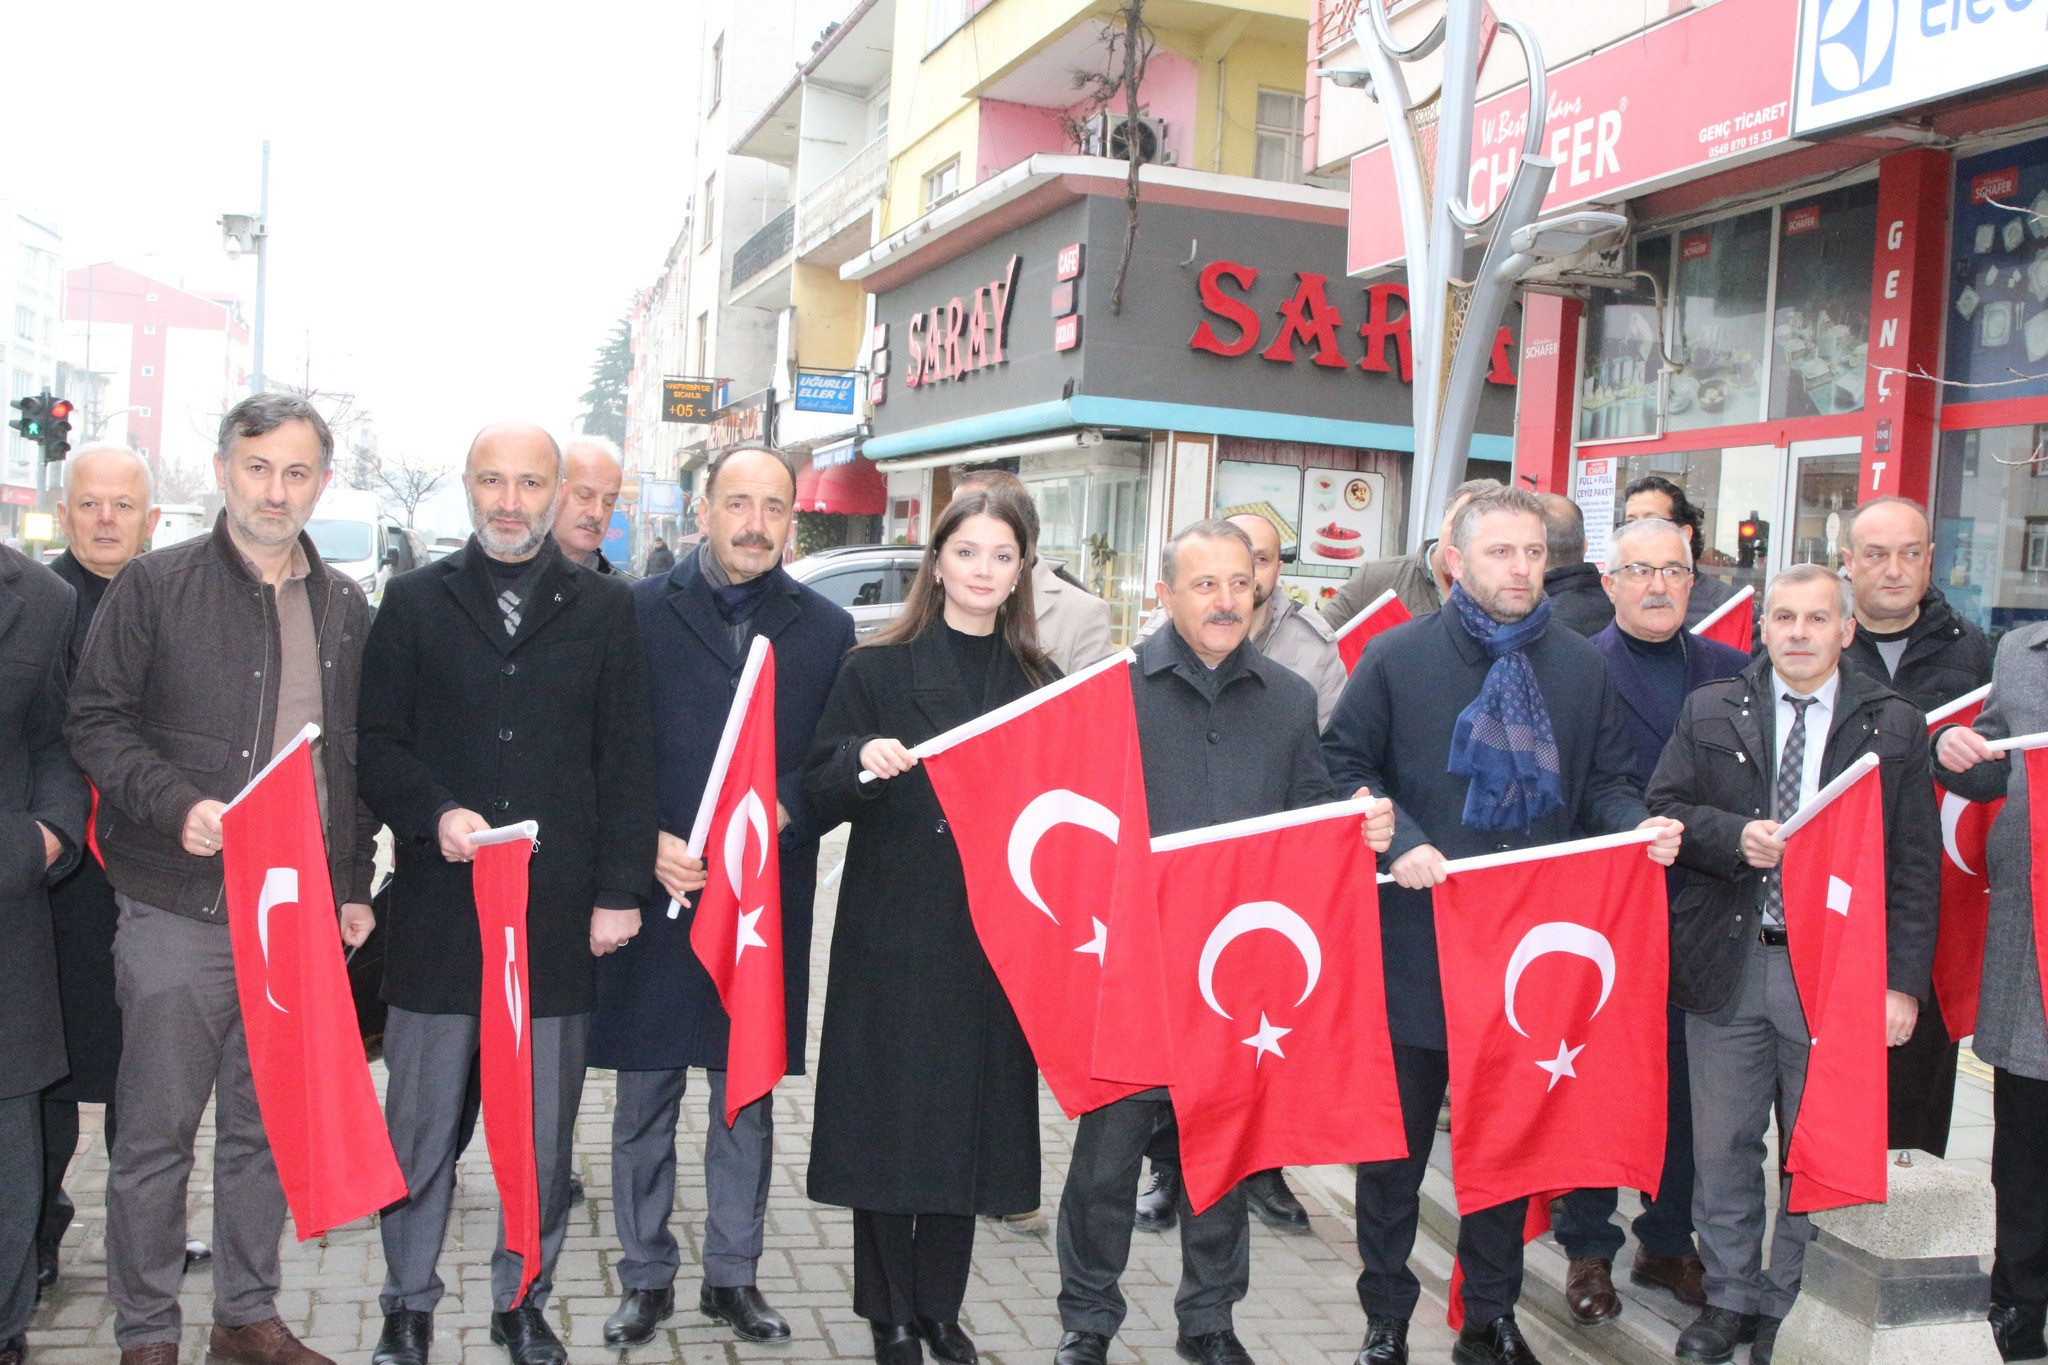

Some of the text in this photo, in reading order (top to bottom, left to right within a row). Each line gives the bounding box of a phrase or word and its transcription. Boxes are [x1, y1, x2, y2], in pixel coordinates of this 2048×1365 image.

[1699, 101, 1788, 143] GENÇ TİCARET
[1708, 129, 1772, 158] 0549 870 15 33
[905, 253, 1016, 388] SARAY
[798, 387, 836, 399] ELLER
[799, 376, 852, 390] UĞURLU
[668, 403, 694, 417] +05
